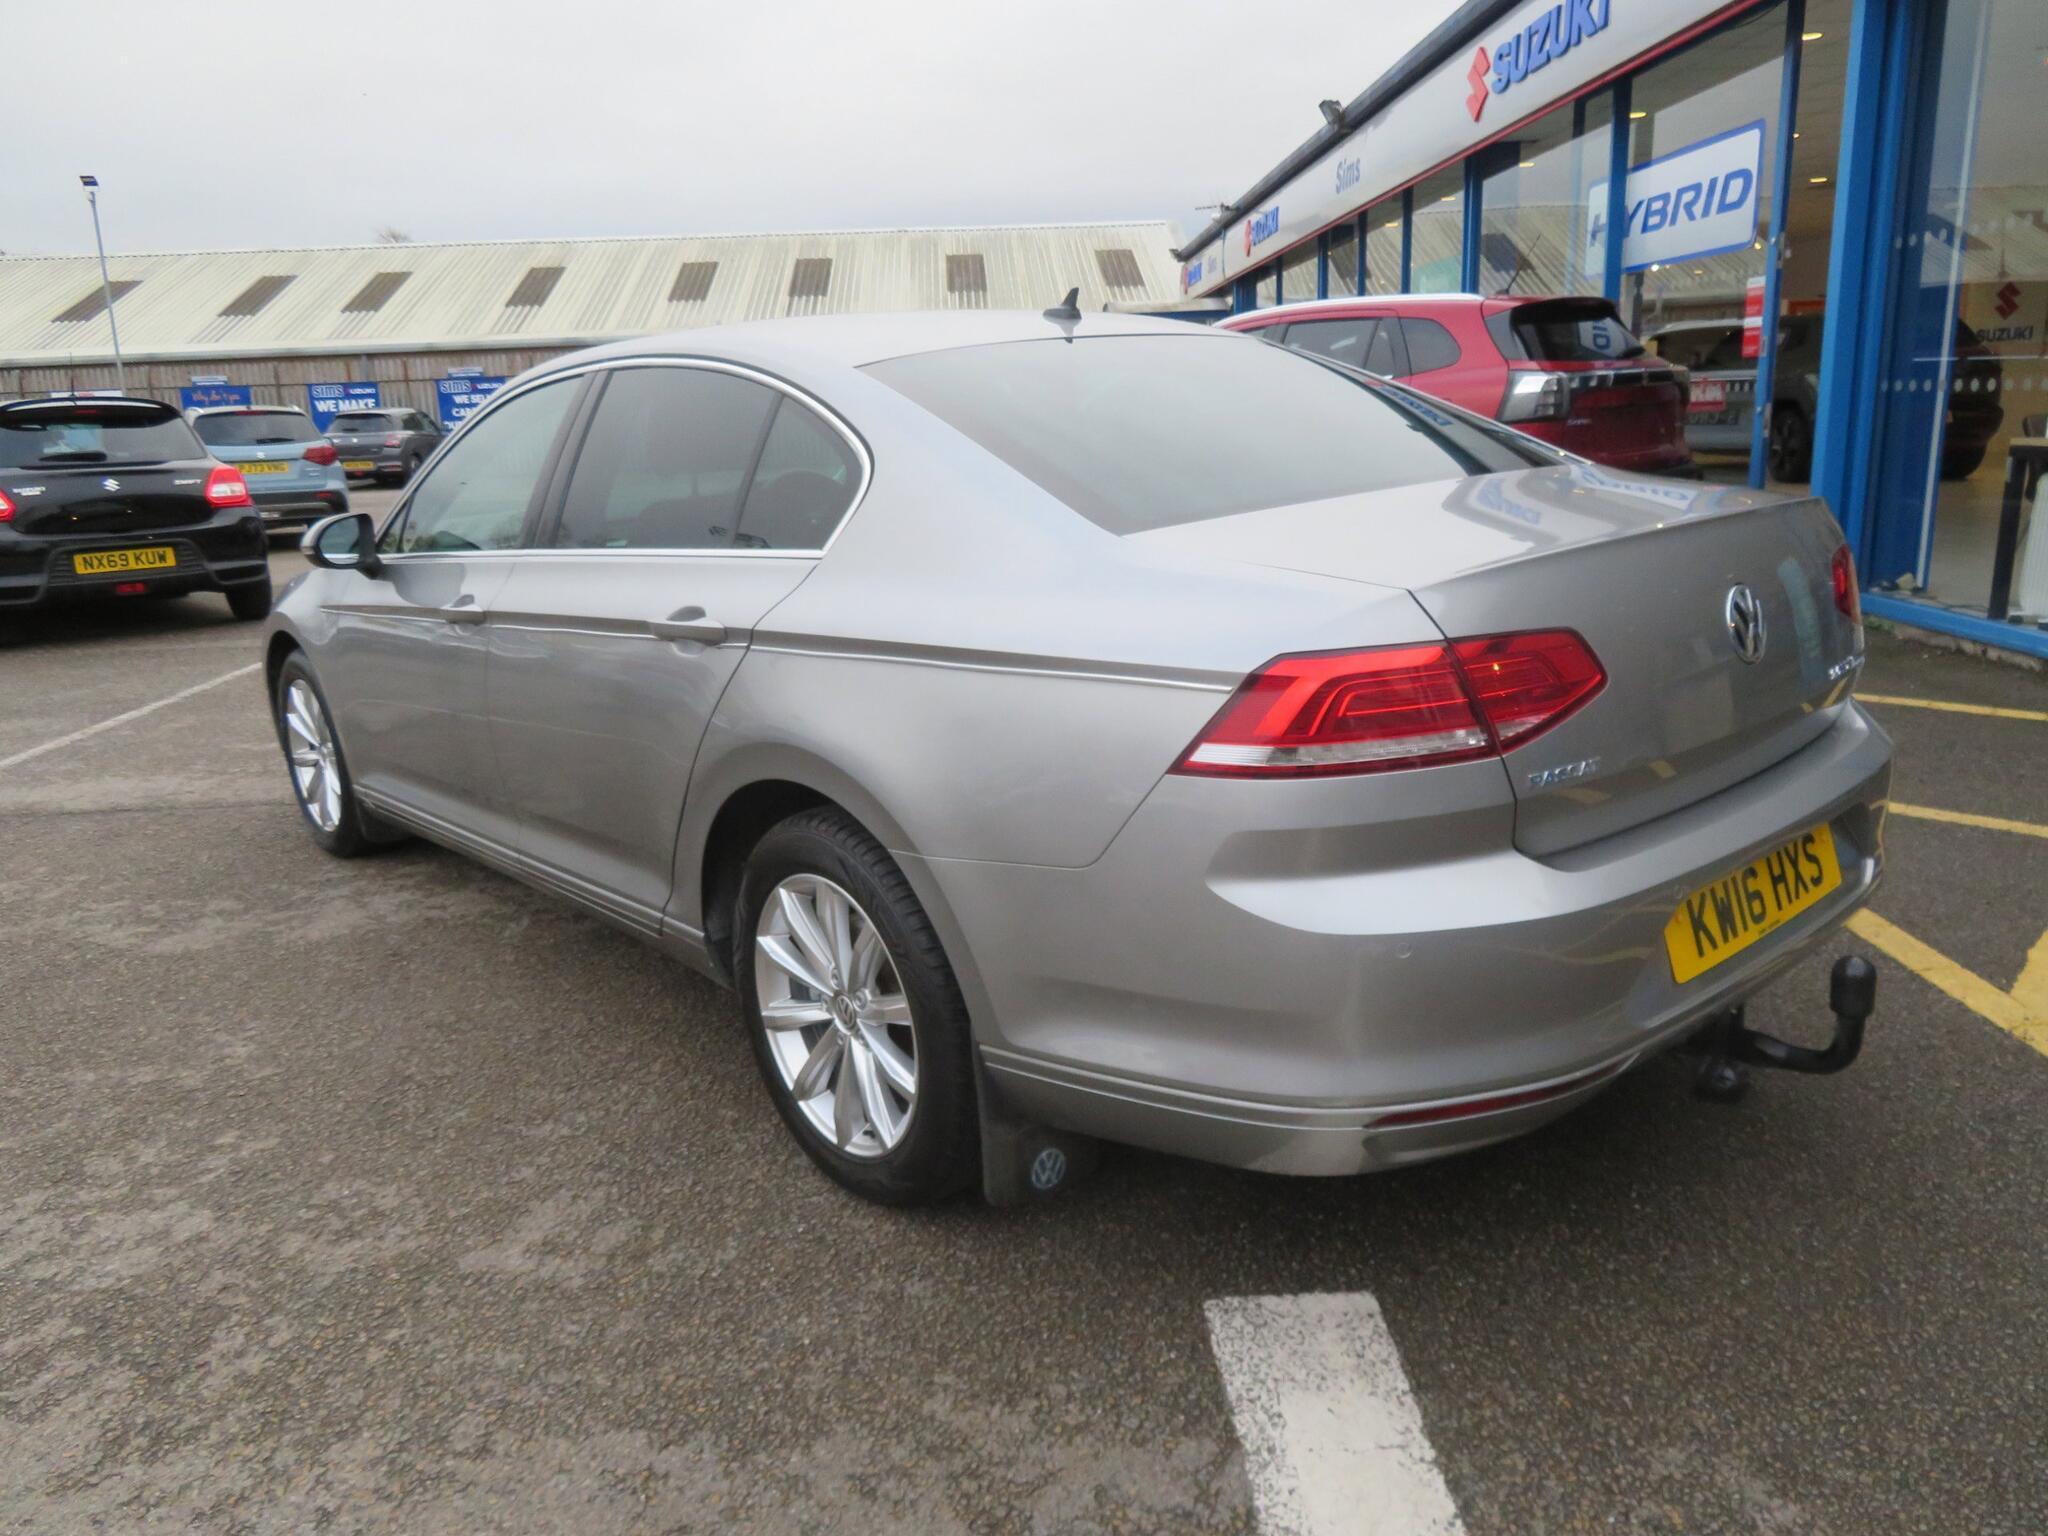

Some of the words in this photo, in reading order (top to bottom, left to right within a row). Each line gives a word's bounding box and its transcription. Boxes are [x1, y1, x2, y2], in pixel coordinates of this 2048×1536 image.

[1491, 0, 1609, 94] SUZUKI
[1336, 158, 1361, 194] Sims
[1977, 326, 2034, 342] SUZUKI
[314, 400, 337, 412] WE
[338, 398, 376, 411] MAKE
[82, 553, 129, 570] NX69
[134, 550, 168, 566] KUW
[1686, 866, 1767, 958] KW16
[1766, 832, 1823, 912] HXS
